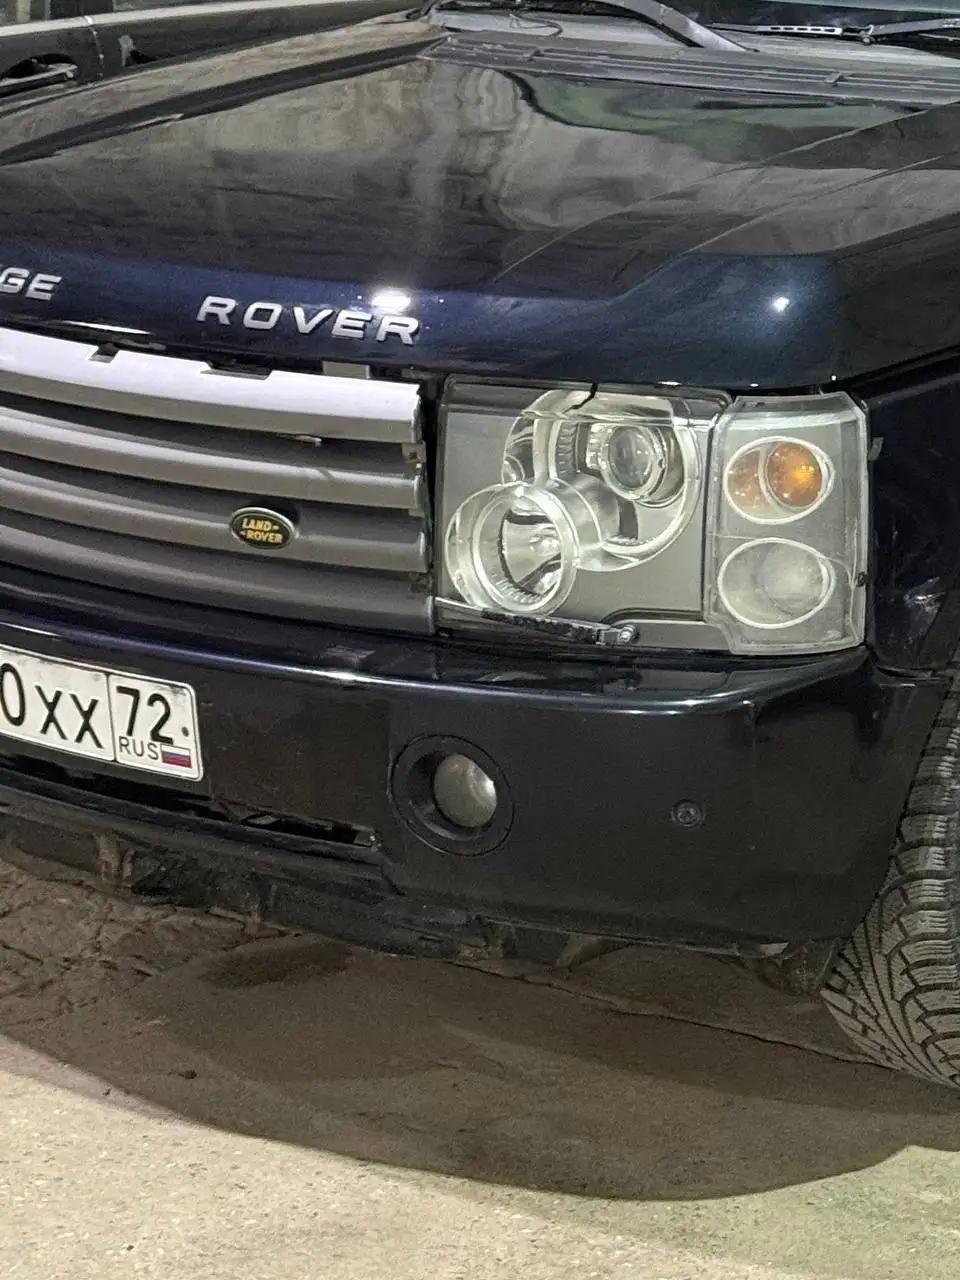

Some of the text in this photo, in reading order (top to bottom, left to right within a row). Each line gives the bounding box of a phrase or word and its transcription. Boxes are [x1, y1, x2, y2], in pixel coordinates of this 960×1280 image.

[0, 267, 419, 346] GE ROVER
[116, 685, 173, 745] 72
[118, 736, 159, 760] RUS
